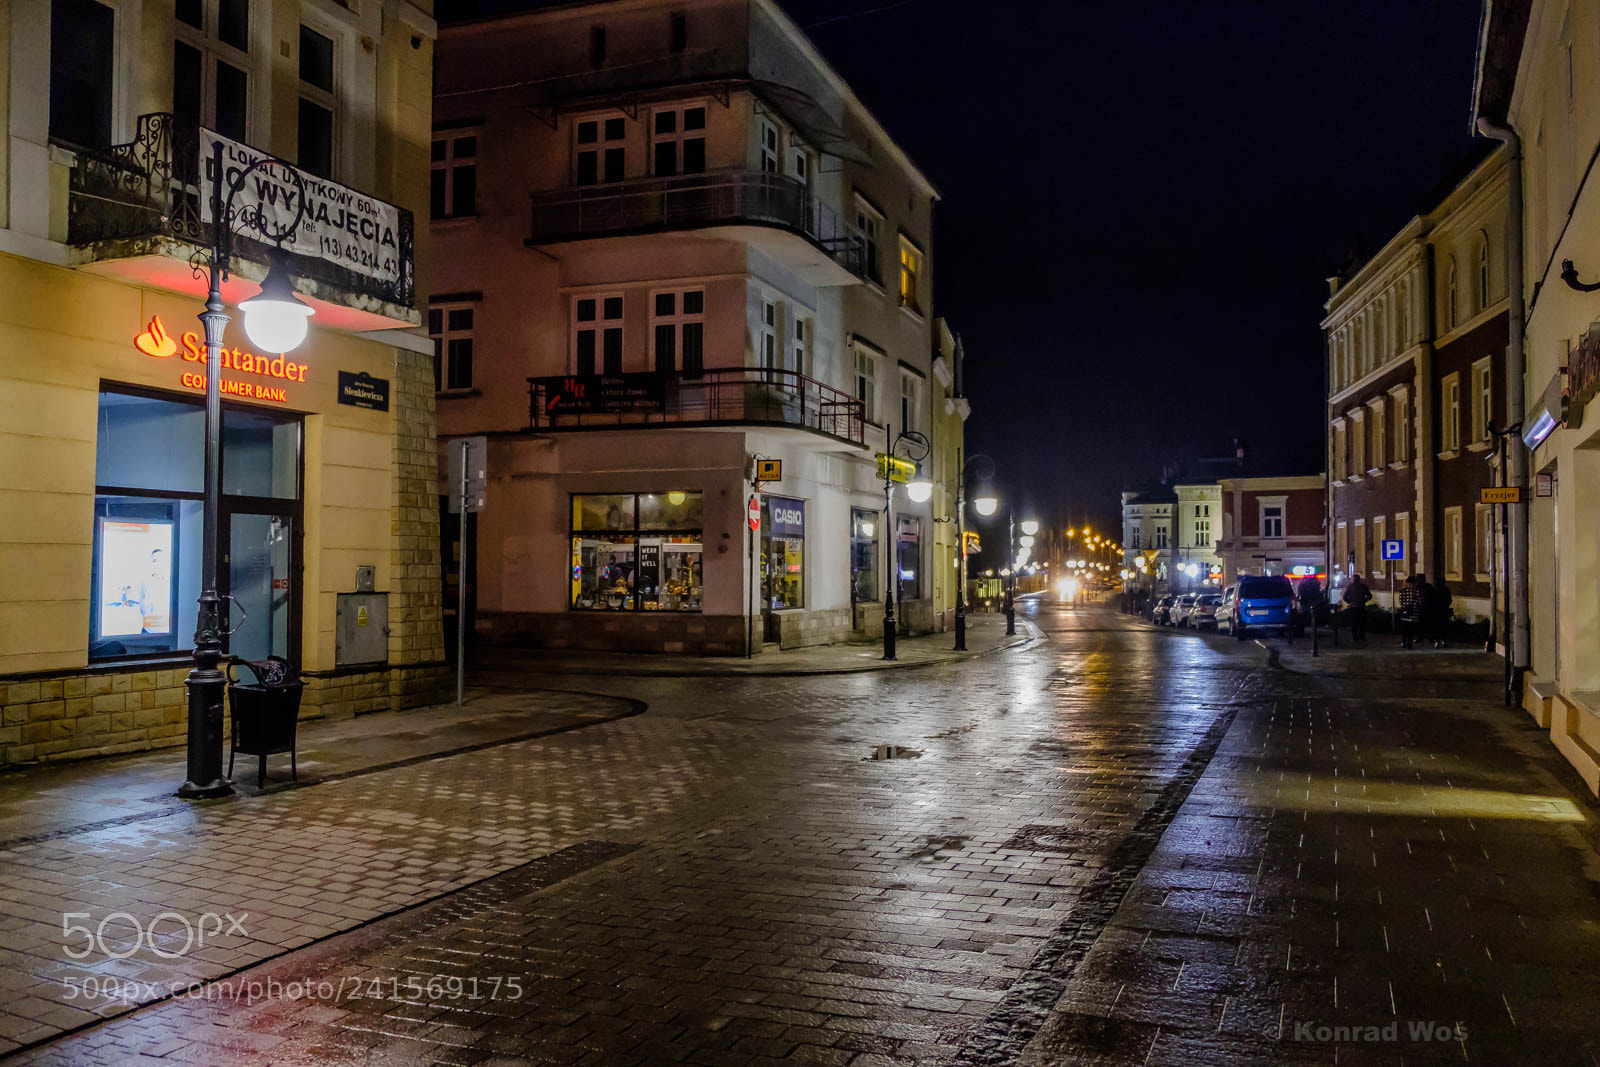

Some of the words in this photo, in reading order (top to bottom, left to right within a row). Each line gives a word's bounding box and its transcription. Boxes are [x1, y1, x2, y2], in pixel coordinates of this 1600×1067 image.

[229, 146, 277, 178] LOKAL
[255, 176, 396, 249] WYNAJĘCIA
[346, 244, 359, 263] 43
[361, 250, 380, 270] 214
[384, 257, 397, 275] 43
[182, 331, 308, 382] Santander
[182, 372, 252, 396] COUMER
[255, 385, 287, 402] BANK
[774, 508, 802, 525] CASIO
[1386, 541, 1400, 558] P
